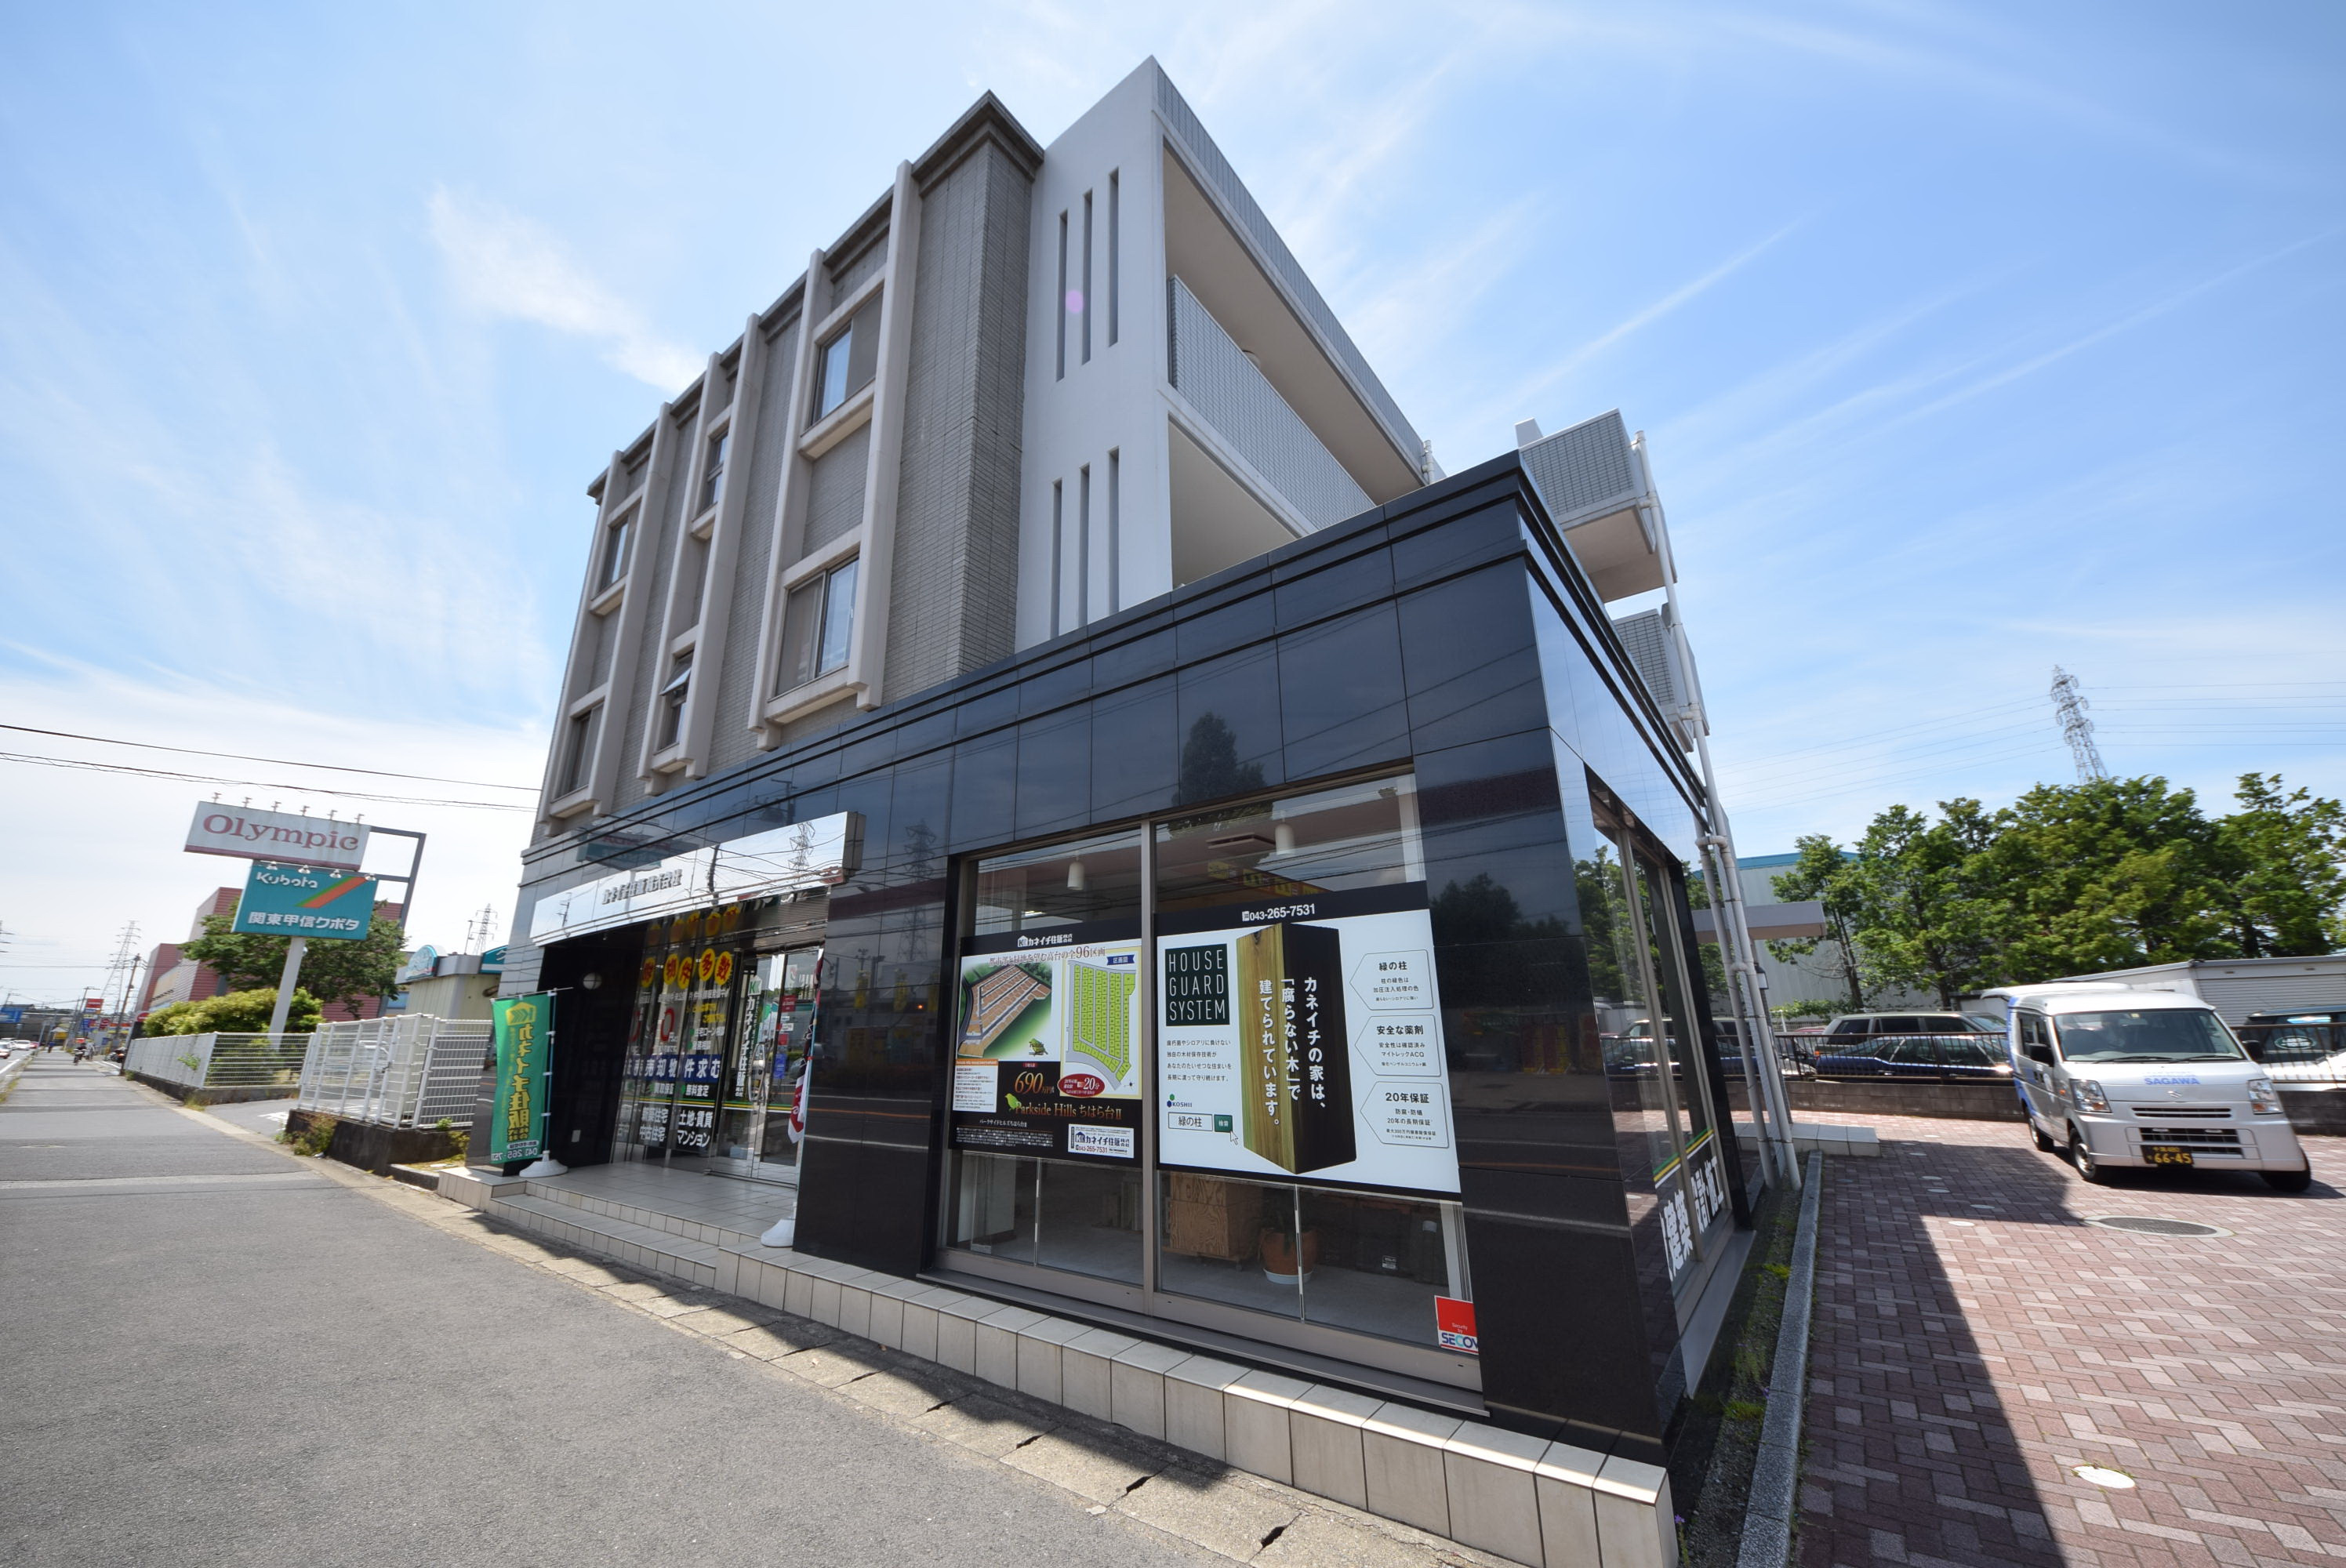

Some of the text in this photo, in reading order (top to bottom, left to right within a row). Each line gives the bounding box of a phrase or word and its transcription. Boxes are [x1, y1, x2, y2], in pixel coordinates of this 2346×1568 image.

[202, 814, 359, 851] Olympic
[256, 871, 318, 889] Kubota
[248, 911, 361, 932] 関東甲信クボタ
[1249, 903, 1316, 921] 043-265-7531
[1168, 949, 1224, 973] HOUSE
[1378, 960, 1407, 971] 緑の柱
[1169, 974, 1225, 996] GUARD
[1169, 999, 1226, 1021] SYSTEM
[1280, 978, 1302, 1102] 「腐らない木」で
[1376, 1025, 1424, 1035] 安全な薬剤
[1258, 978, 1280, 1126] 建てられています。
[1304, 976, 1326, 1109] カネイチの家は、
[1385, 1092, 1430, 1104] 20年保証
[1015, 1102, 1051, 1116] Parkside
[1054, 1103, 1077, 1117] Hills
[1178, 1116, 1203, 1127] 緑の柱
[677, 1129, 710, 1148] マンション
